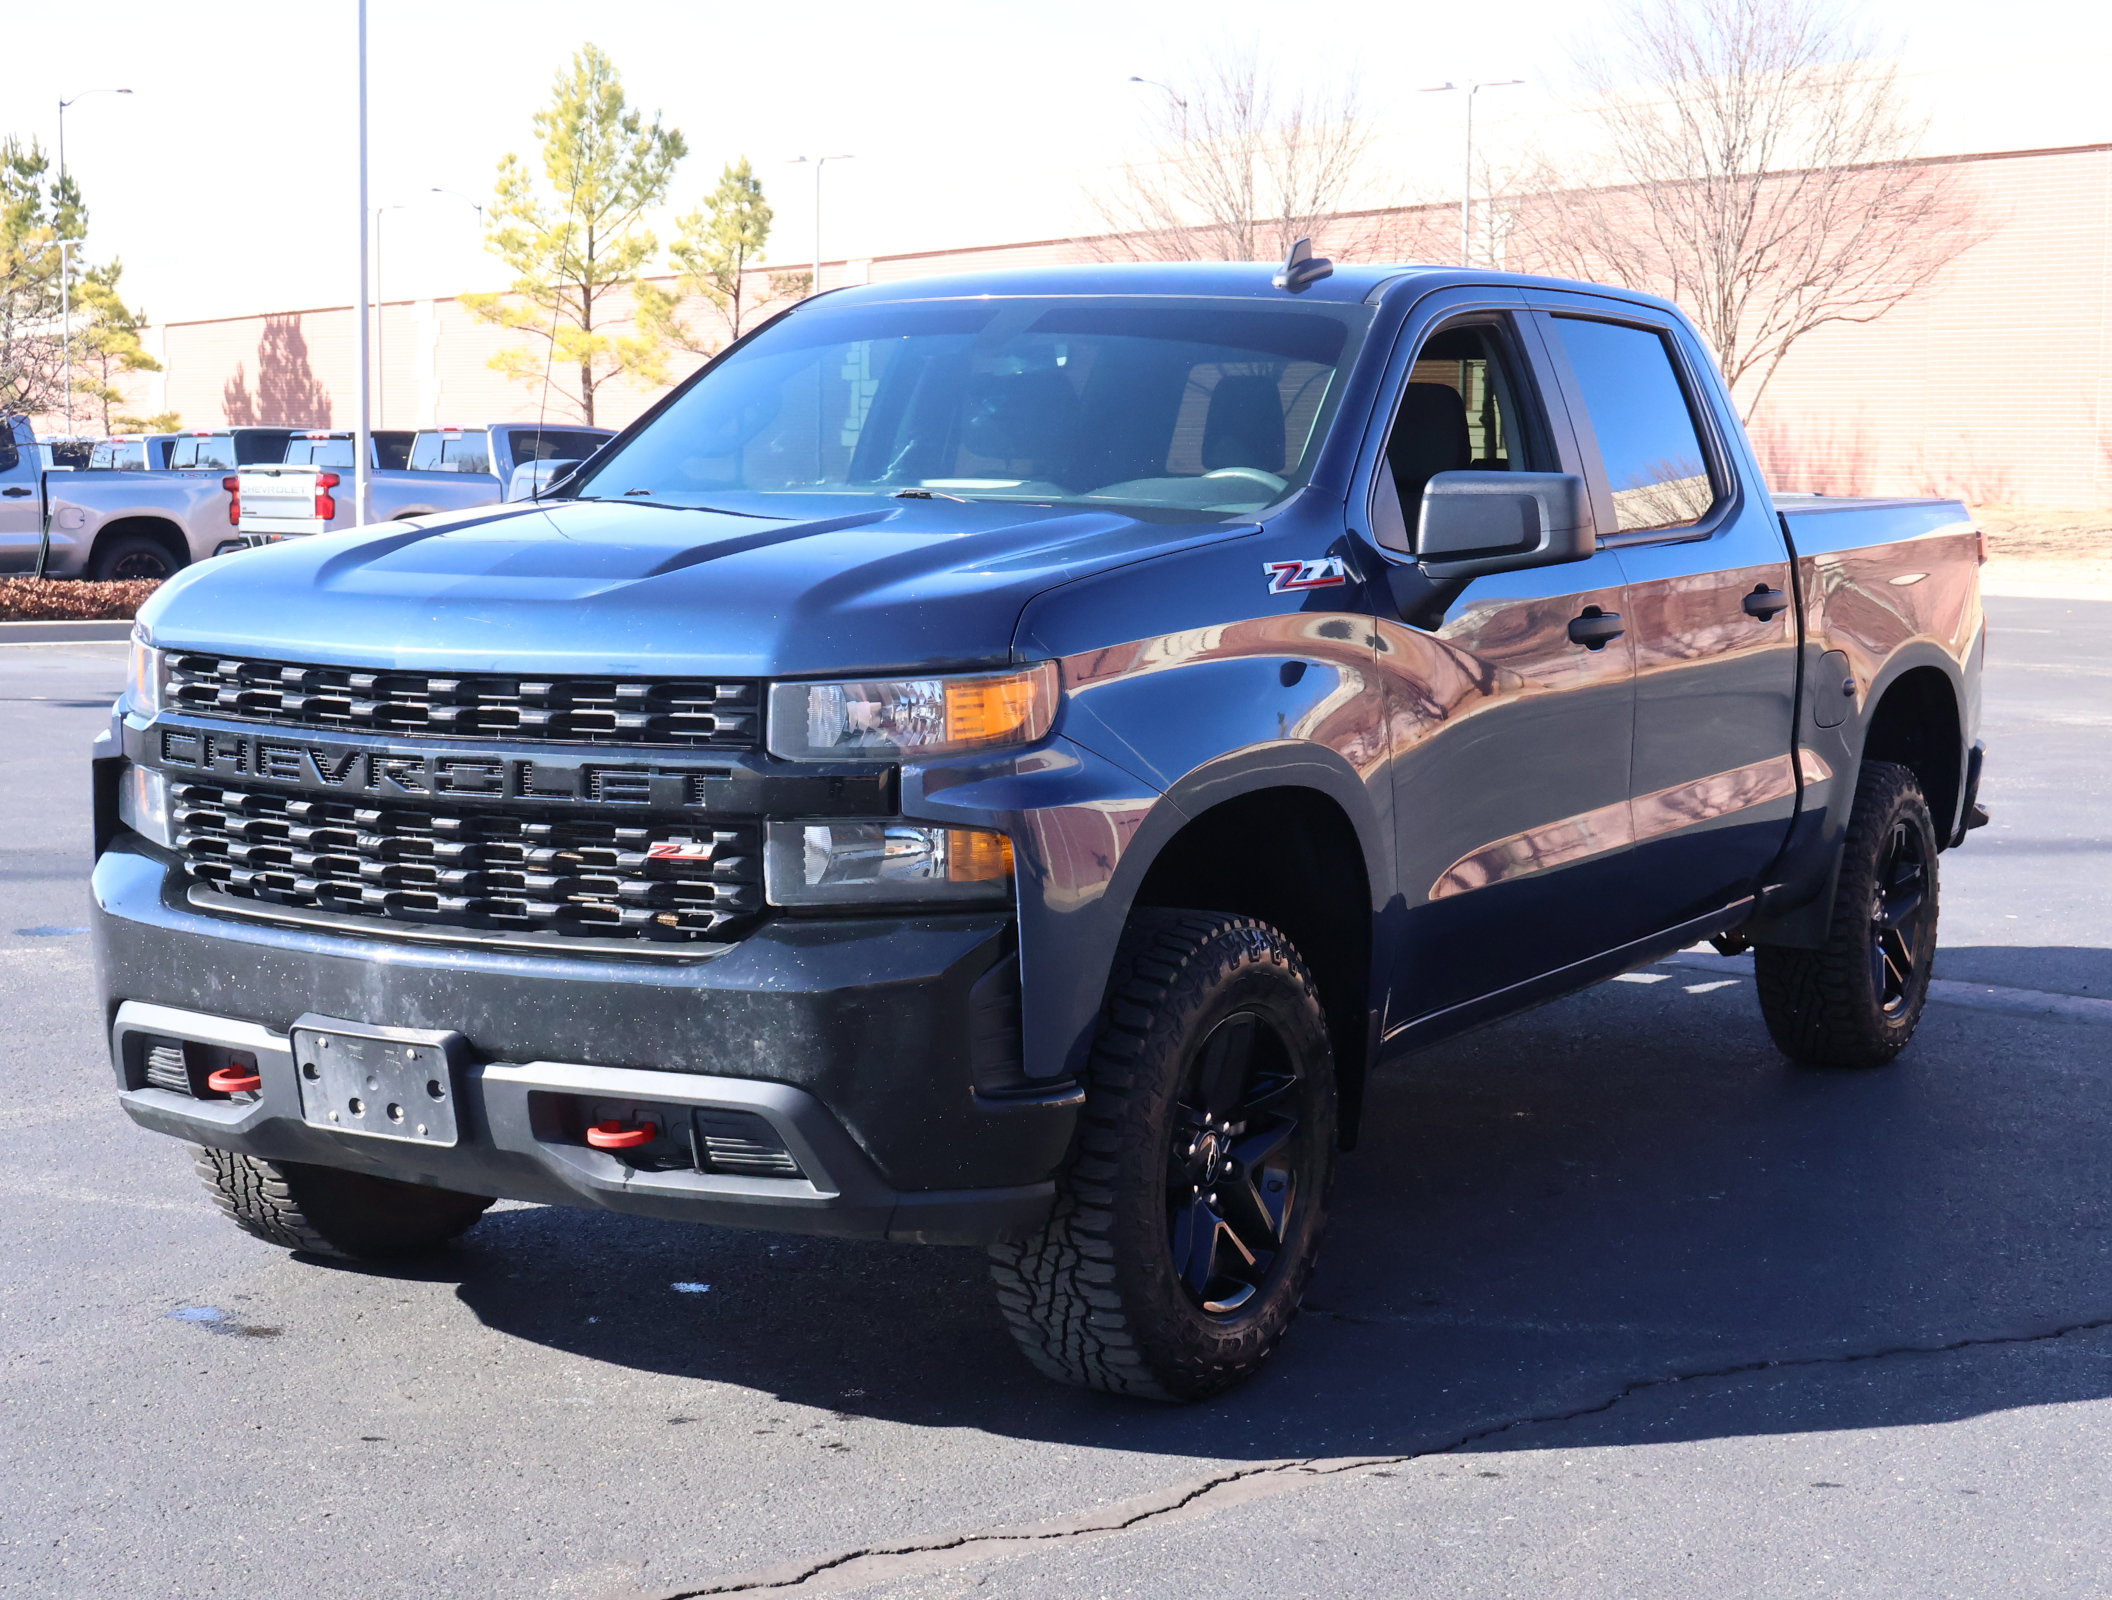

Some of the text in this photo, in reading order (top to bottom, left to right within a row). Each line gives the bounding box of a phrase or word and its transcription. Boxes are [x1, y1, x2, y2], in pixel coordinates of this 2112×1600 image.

[241, 485, 305, 495] CHEVROLET
[1262, 556, 1346, 595] Z71
[161, 730, 734, 806] CHEVROLET
